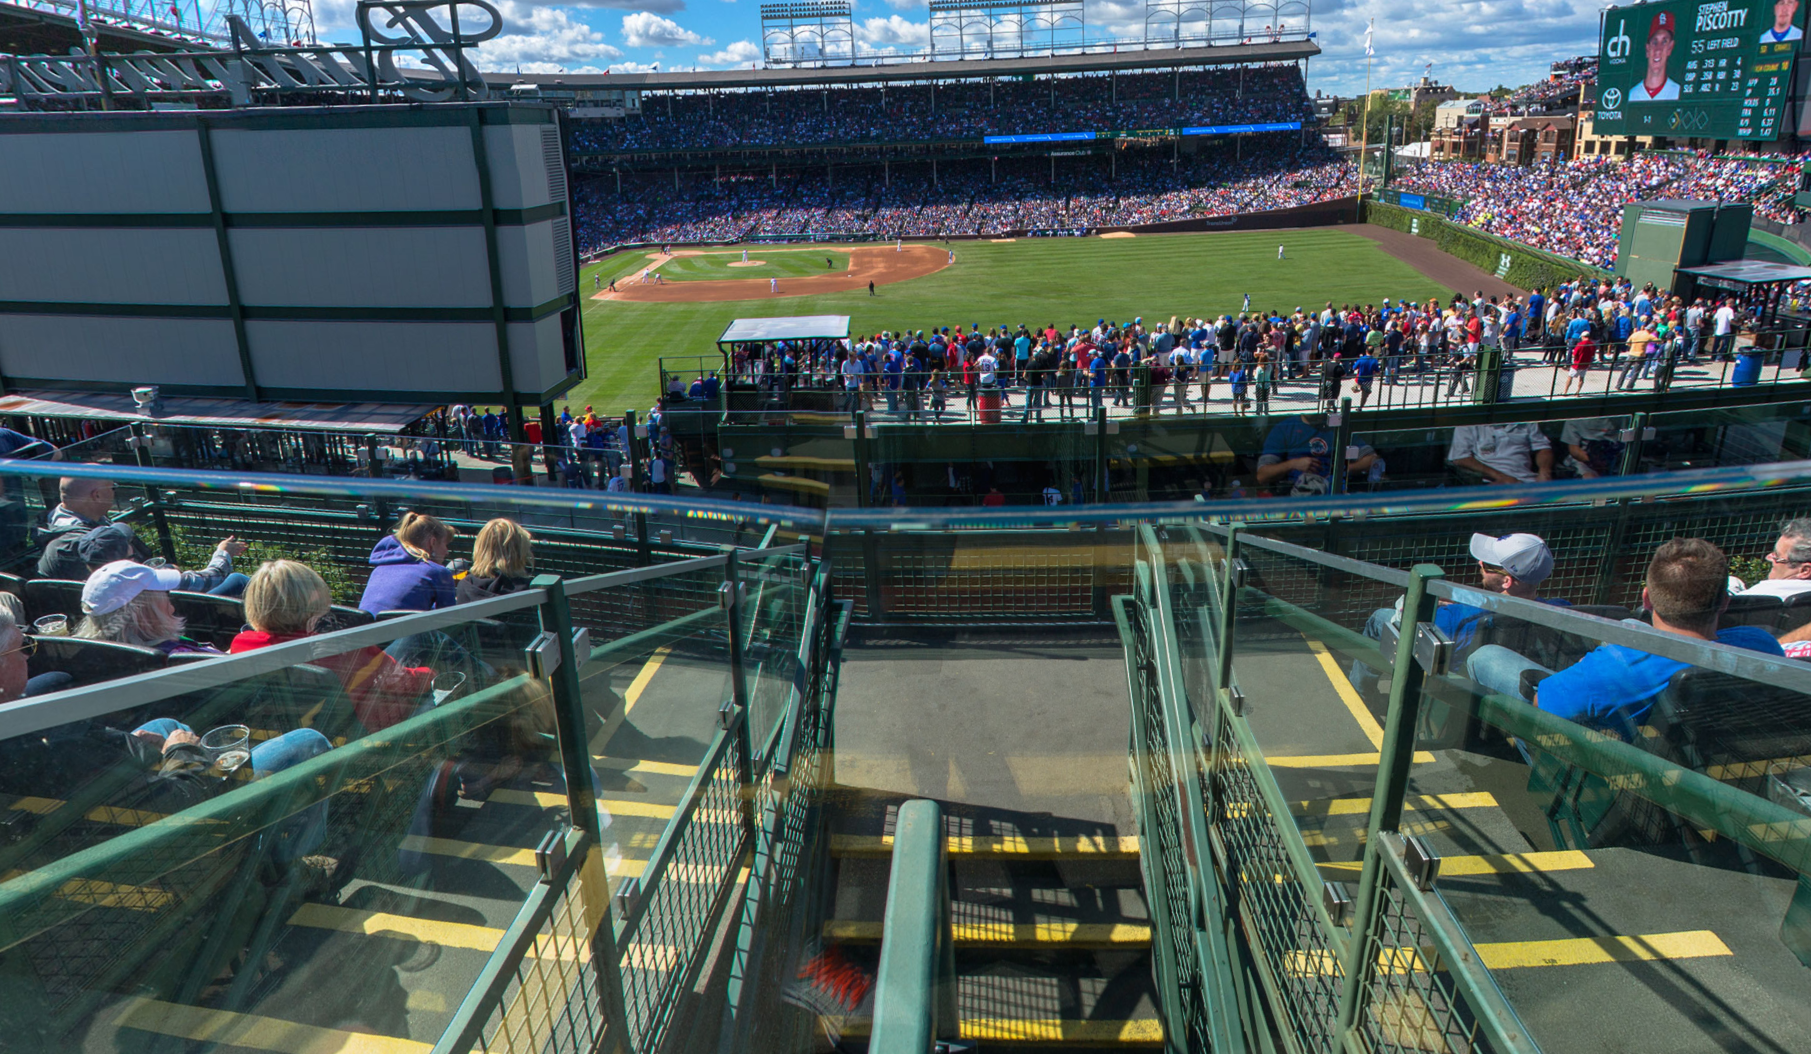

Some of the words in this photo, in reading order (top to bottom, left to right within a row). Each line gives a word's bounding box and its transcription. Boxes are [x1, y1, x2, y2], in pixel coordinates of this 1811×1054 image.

[1698, 1, 1728, 15] STEPHEN
[1695, 8, 1748, 32] PISCOTTY
[1607, 19, 1630, 57] ch
[1691, 39, 1705, 54] 55
[1707, 39, 1720, 50] LEFT
[1721, 37, 1739, 48] FIELD
[1730, 81, 1740, 91] 23
[1597, 111, 1622, 120] TOYOTA
